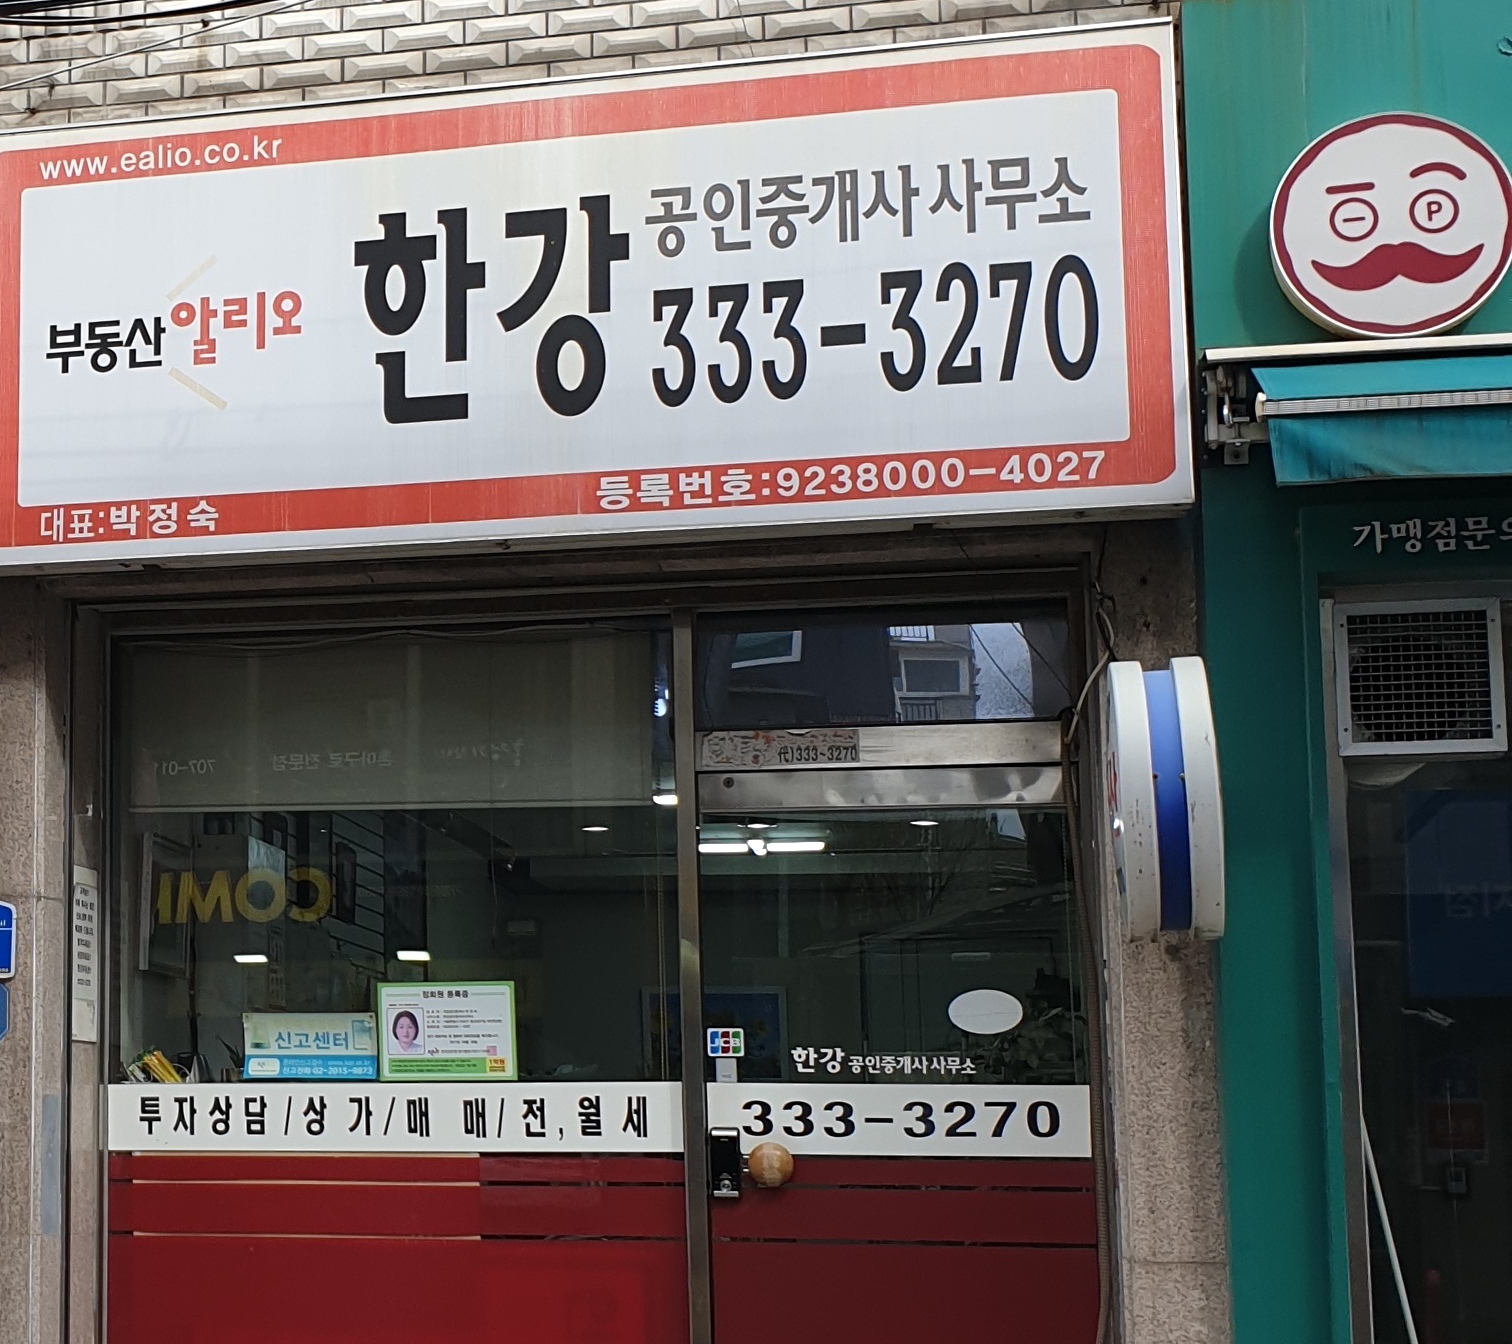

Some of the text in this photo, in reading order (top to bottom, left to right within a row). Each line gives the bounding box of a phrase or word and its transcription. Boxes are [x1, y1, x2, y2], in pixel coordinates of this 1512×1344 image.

[39, 136, 285, 182] www.ealio.co.kr
[353, 155, 1091, 426] 한강 공인중개사 사무소
[45, 317, 167, 375] 부동산
[650, 253, 1100, 408] 333-3270
[595, 449, 1106, 511] 등록번호:9238000-4027
[274, 1031, 350, 1051] 신고센터
[790, 1046, 977, 1075] 한강 공인중개사 사무소
[741, 1099, 1061, 1139] 333-3270
